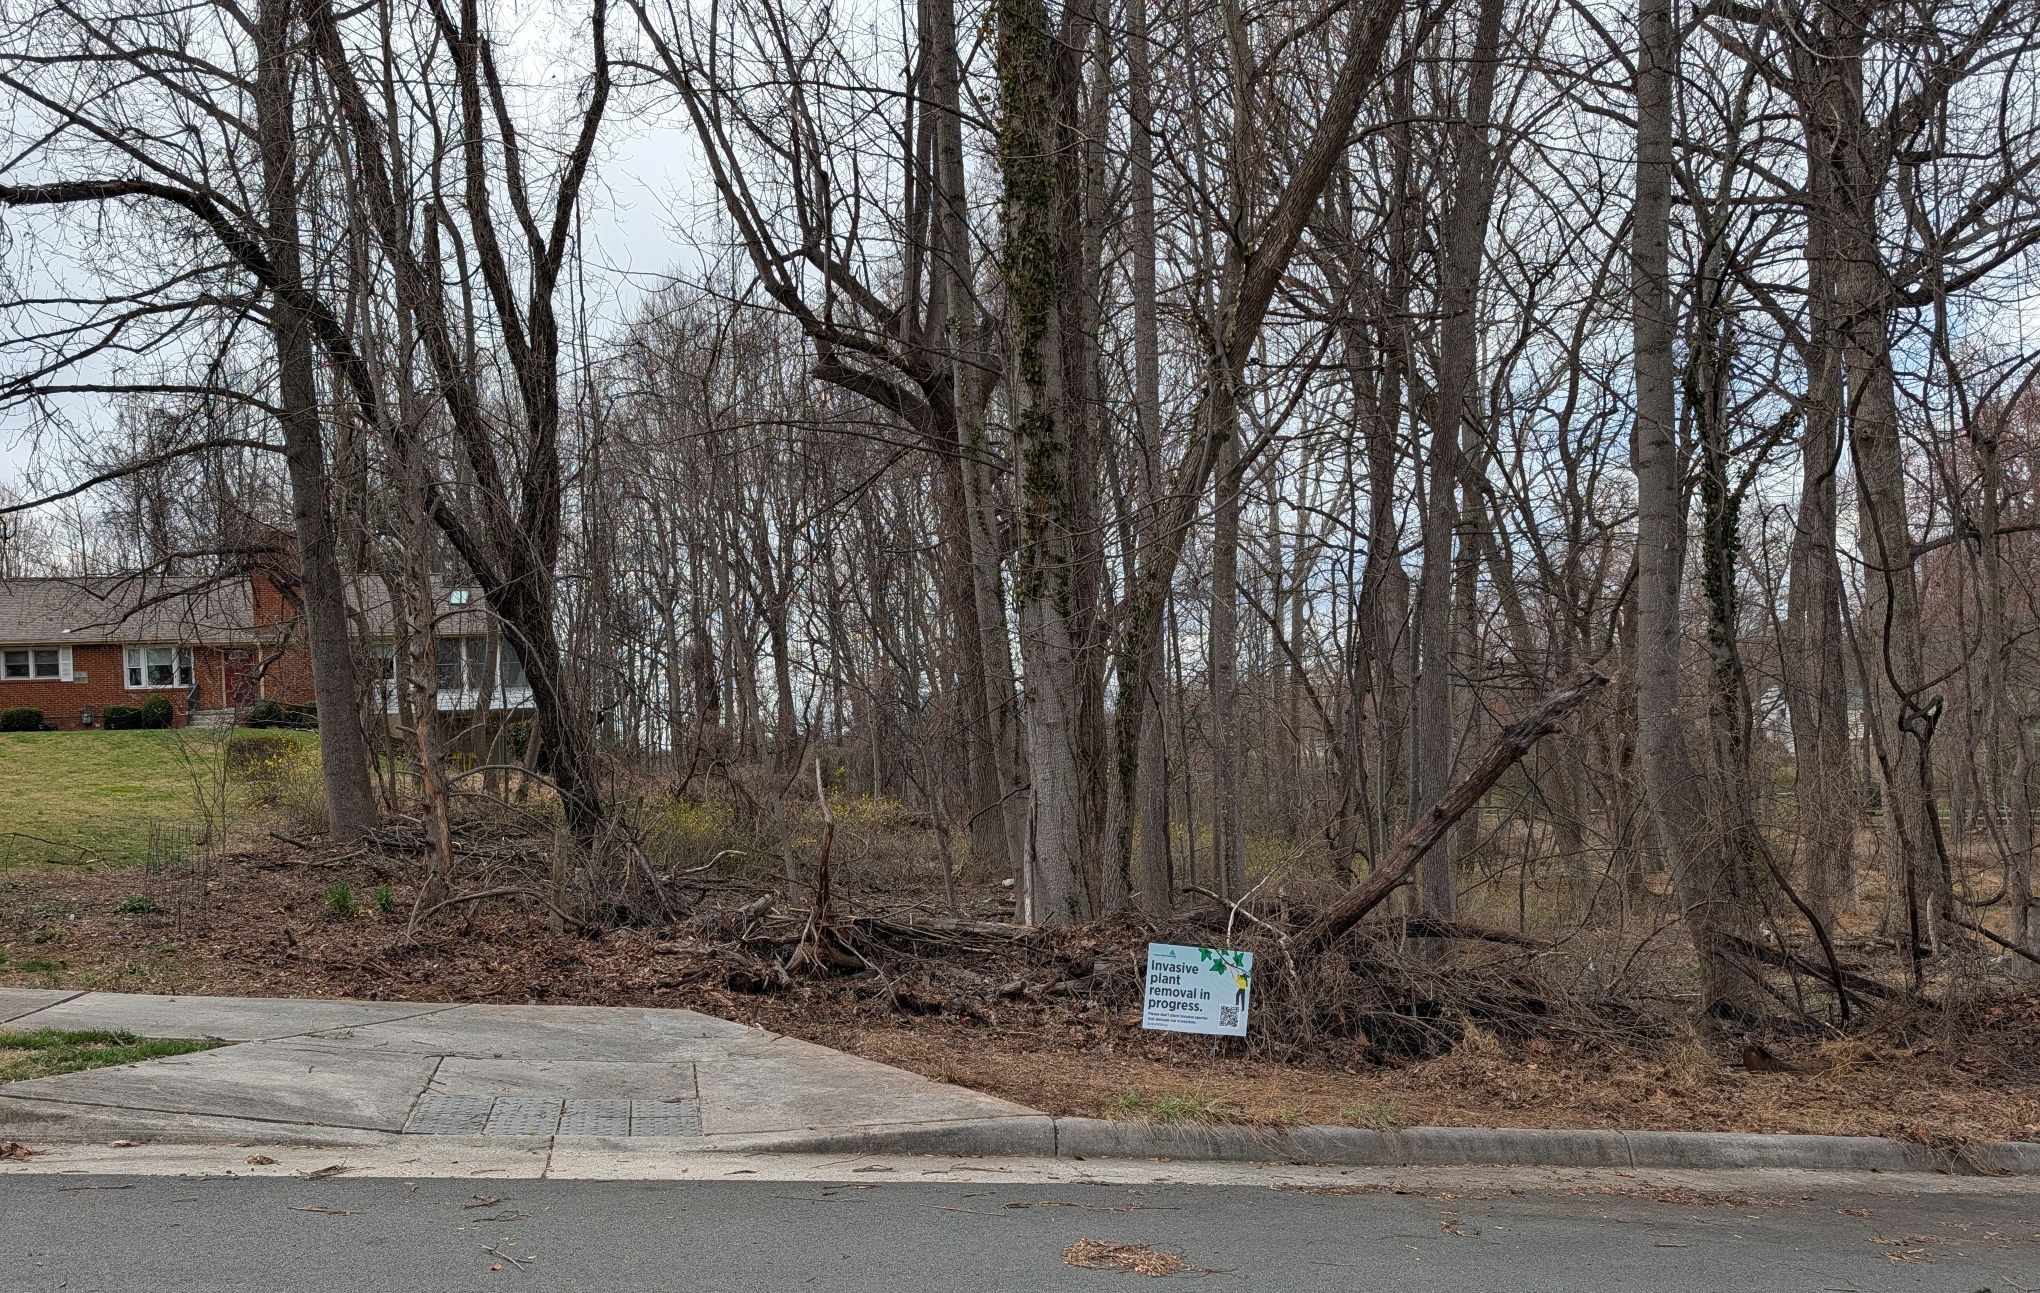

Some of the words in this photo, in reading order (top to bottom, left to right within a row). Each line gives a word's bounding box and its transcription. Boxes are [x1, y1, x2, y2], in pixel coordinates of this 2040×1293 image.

[1151, 960, 1199, 974] Invasive
[1150, 972, 1181, 985] plant
[1149, 986, 1197, 999] removal
[1200, 988, 1211, 1000] in
[1148, 998, 1203, 1012] progress.
